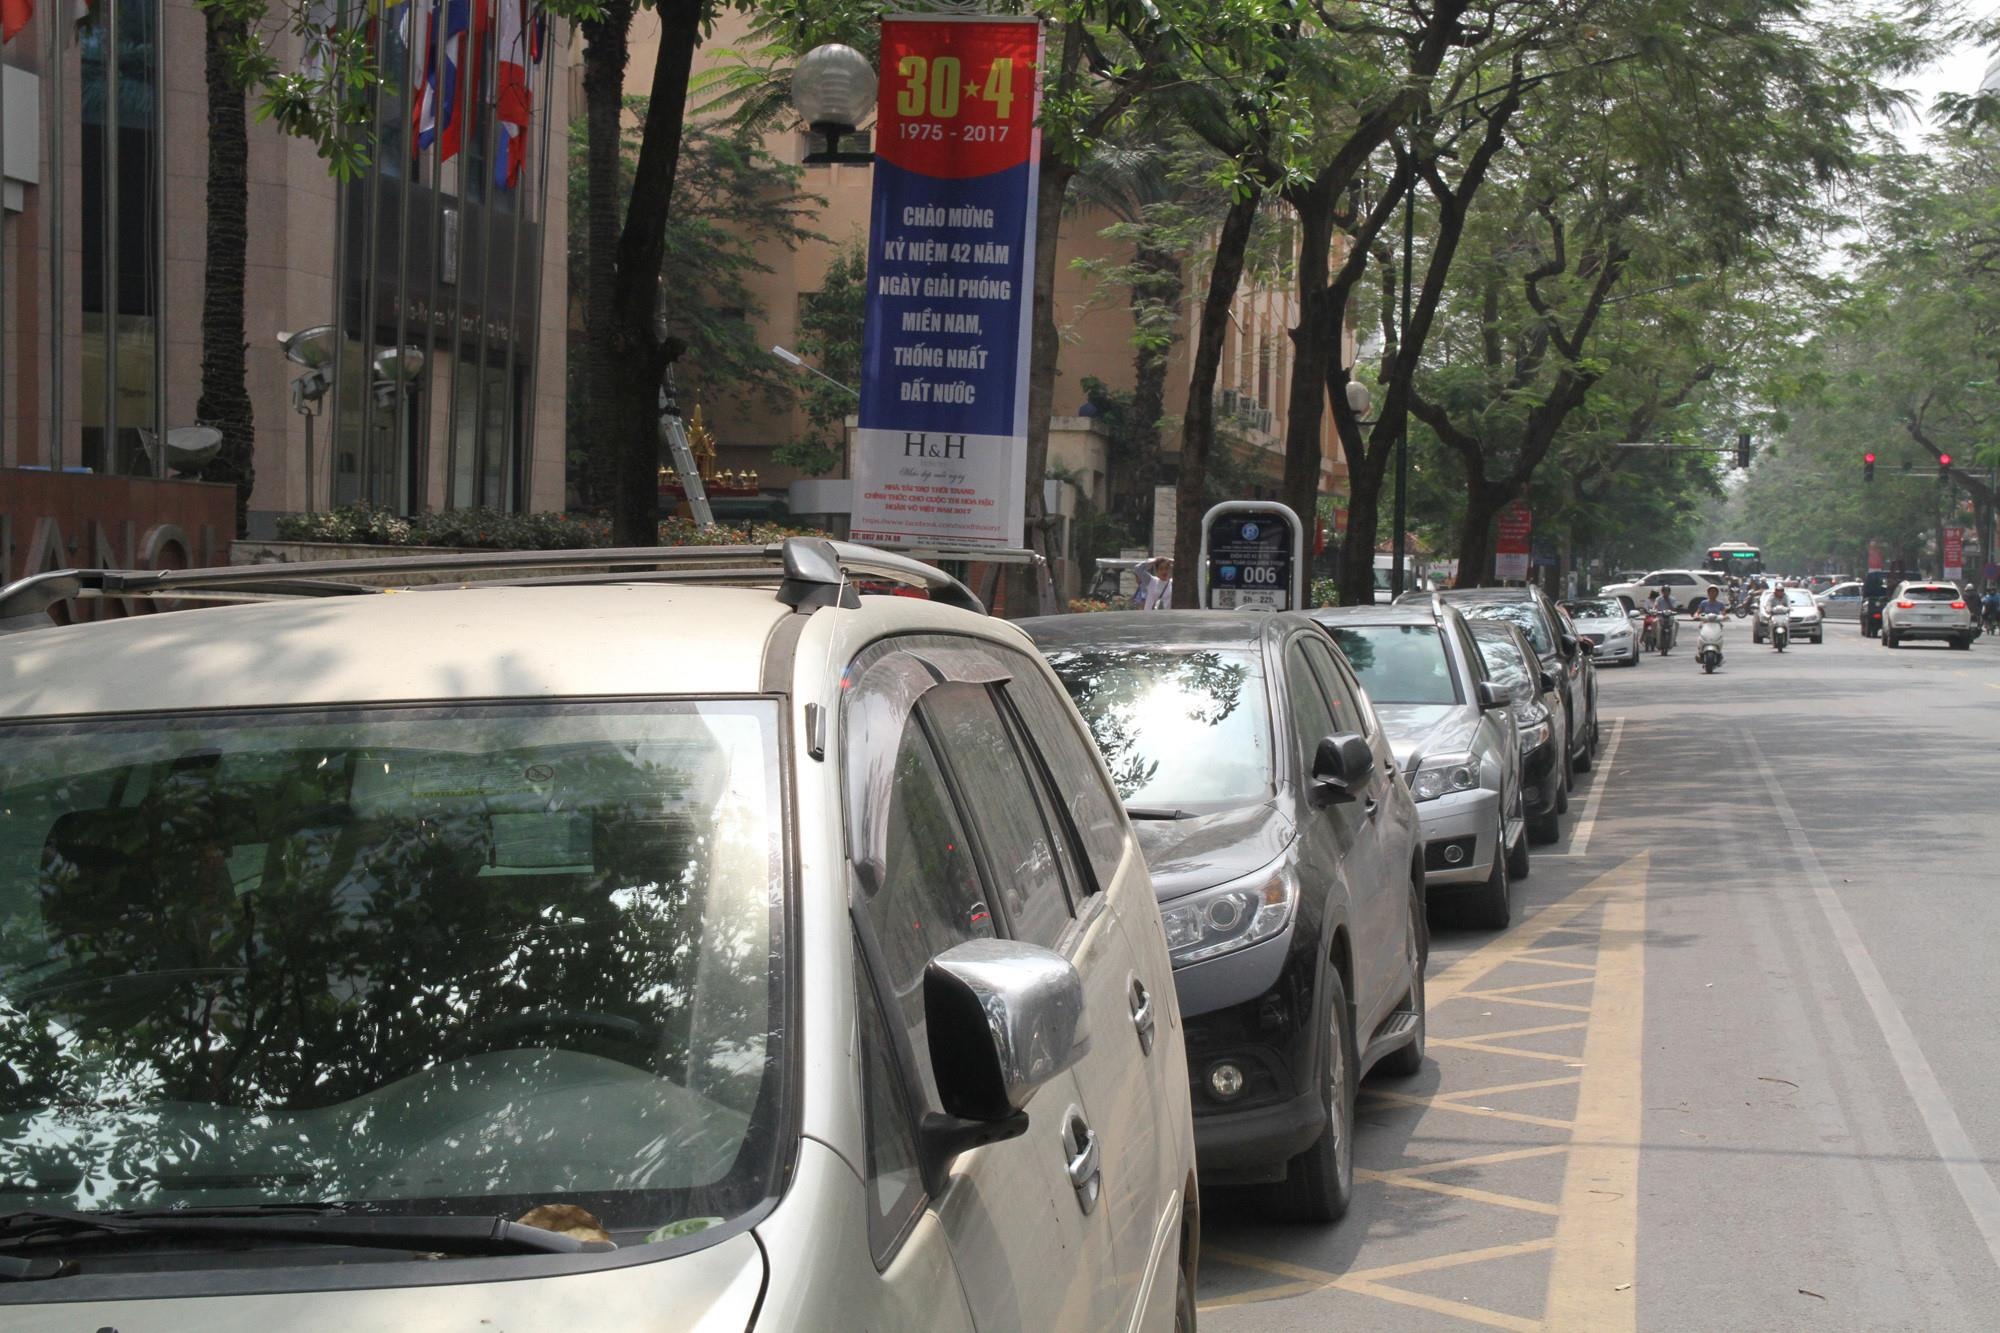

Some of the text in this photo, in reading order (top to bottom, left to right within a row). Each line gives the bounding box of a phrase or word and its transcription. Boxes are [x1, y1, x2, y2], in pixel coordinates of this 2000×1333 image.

[900, 123, 943, 141] 1975
[963, 125, 1009, 142] 2017
[903, 203, 994, 228] CHÀO MỪNG
[908, 239, 948, 266] NIỆM
[950, 243, 971, 263] 42
[974, 242, 1009, 264] NĂM
[879, 273, 1011, 300] NGÀY GIẢI PHÓNG
[902, 307, 983, 336] MIỀN NAM,
[894, 343, 988, 369] THỐNG NHẤT
[901, 377, 976, 404] ĐẤT NƯỚC
[904, 432, 967, 459] H&H
[1243, 566, 1276, 583] 006
